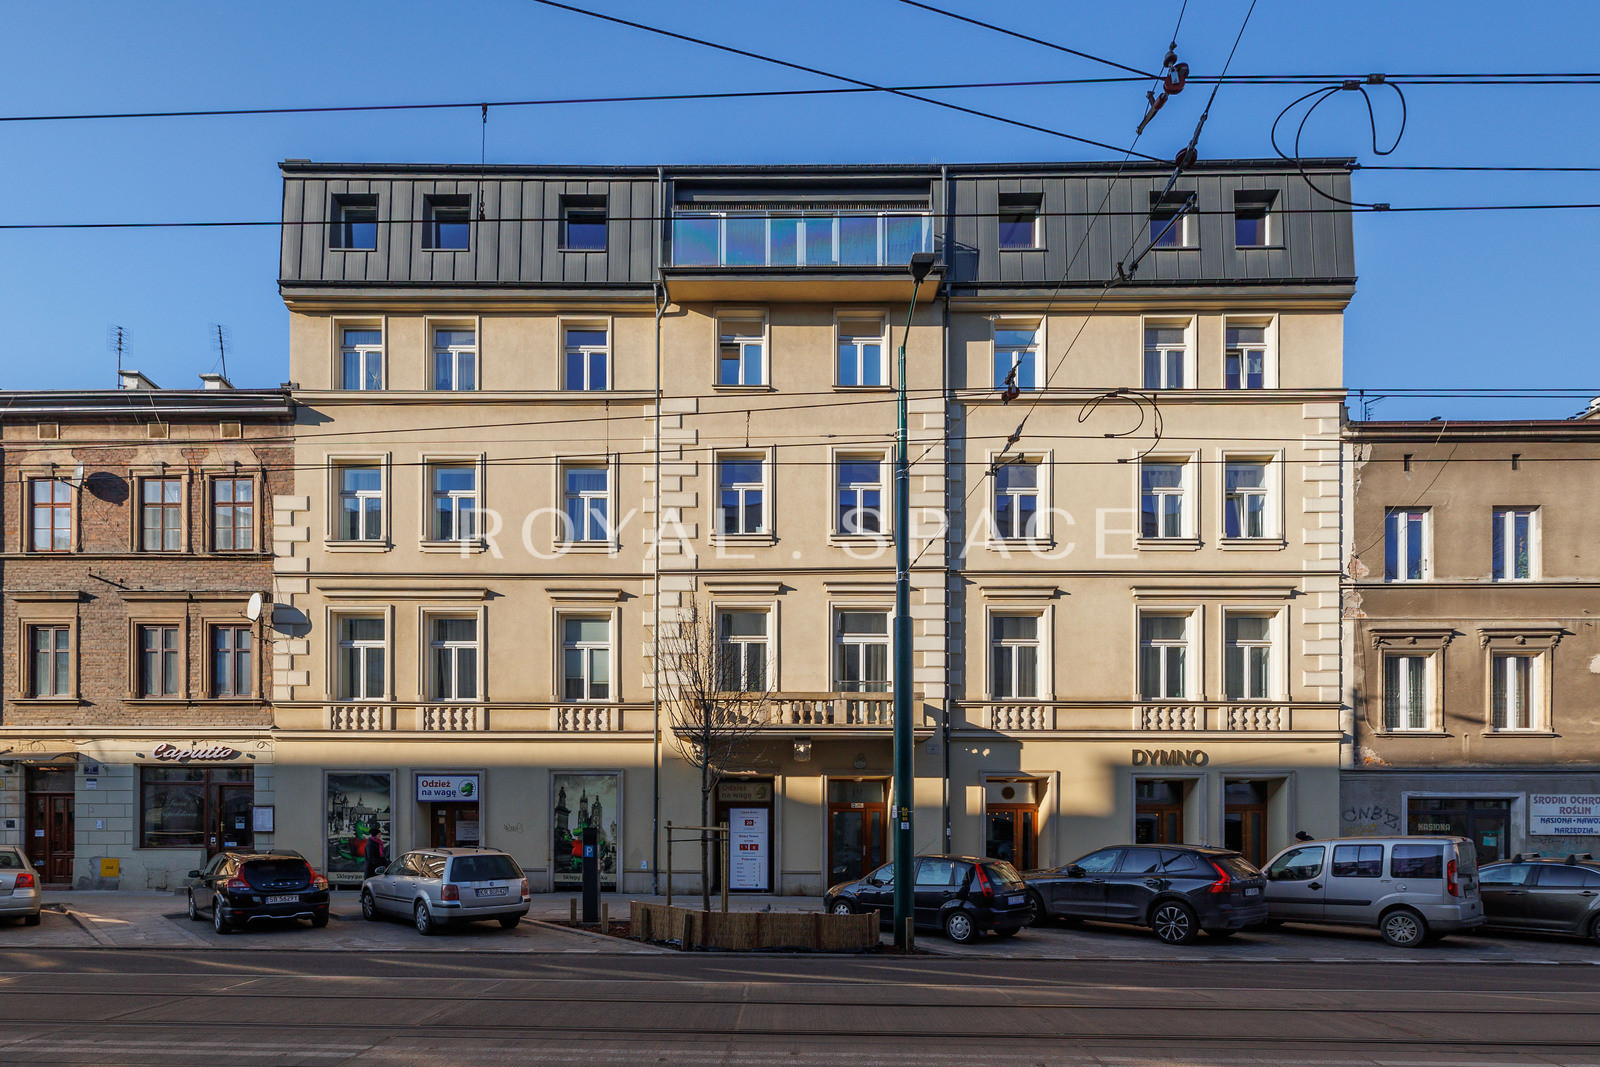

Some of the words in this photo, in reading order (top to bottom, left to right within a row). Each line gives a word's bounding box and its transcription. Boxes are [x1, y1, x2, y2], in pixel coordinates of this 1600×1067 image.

[1132, 749, 1209, 766] DYMNO
[1533, 795, 1566, 804] ŚRODKI
[1559, 805, 1591, 814] ROŚLIN
[586, 847, 593, 855] P
